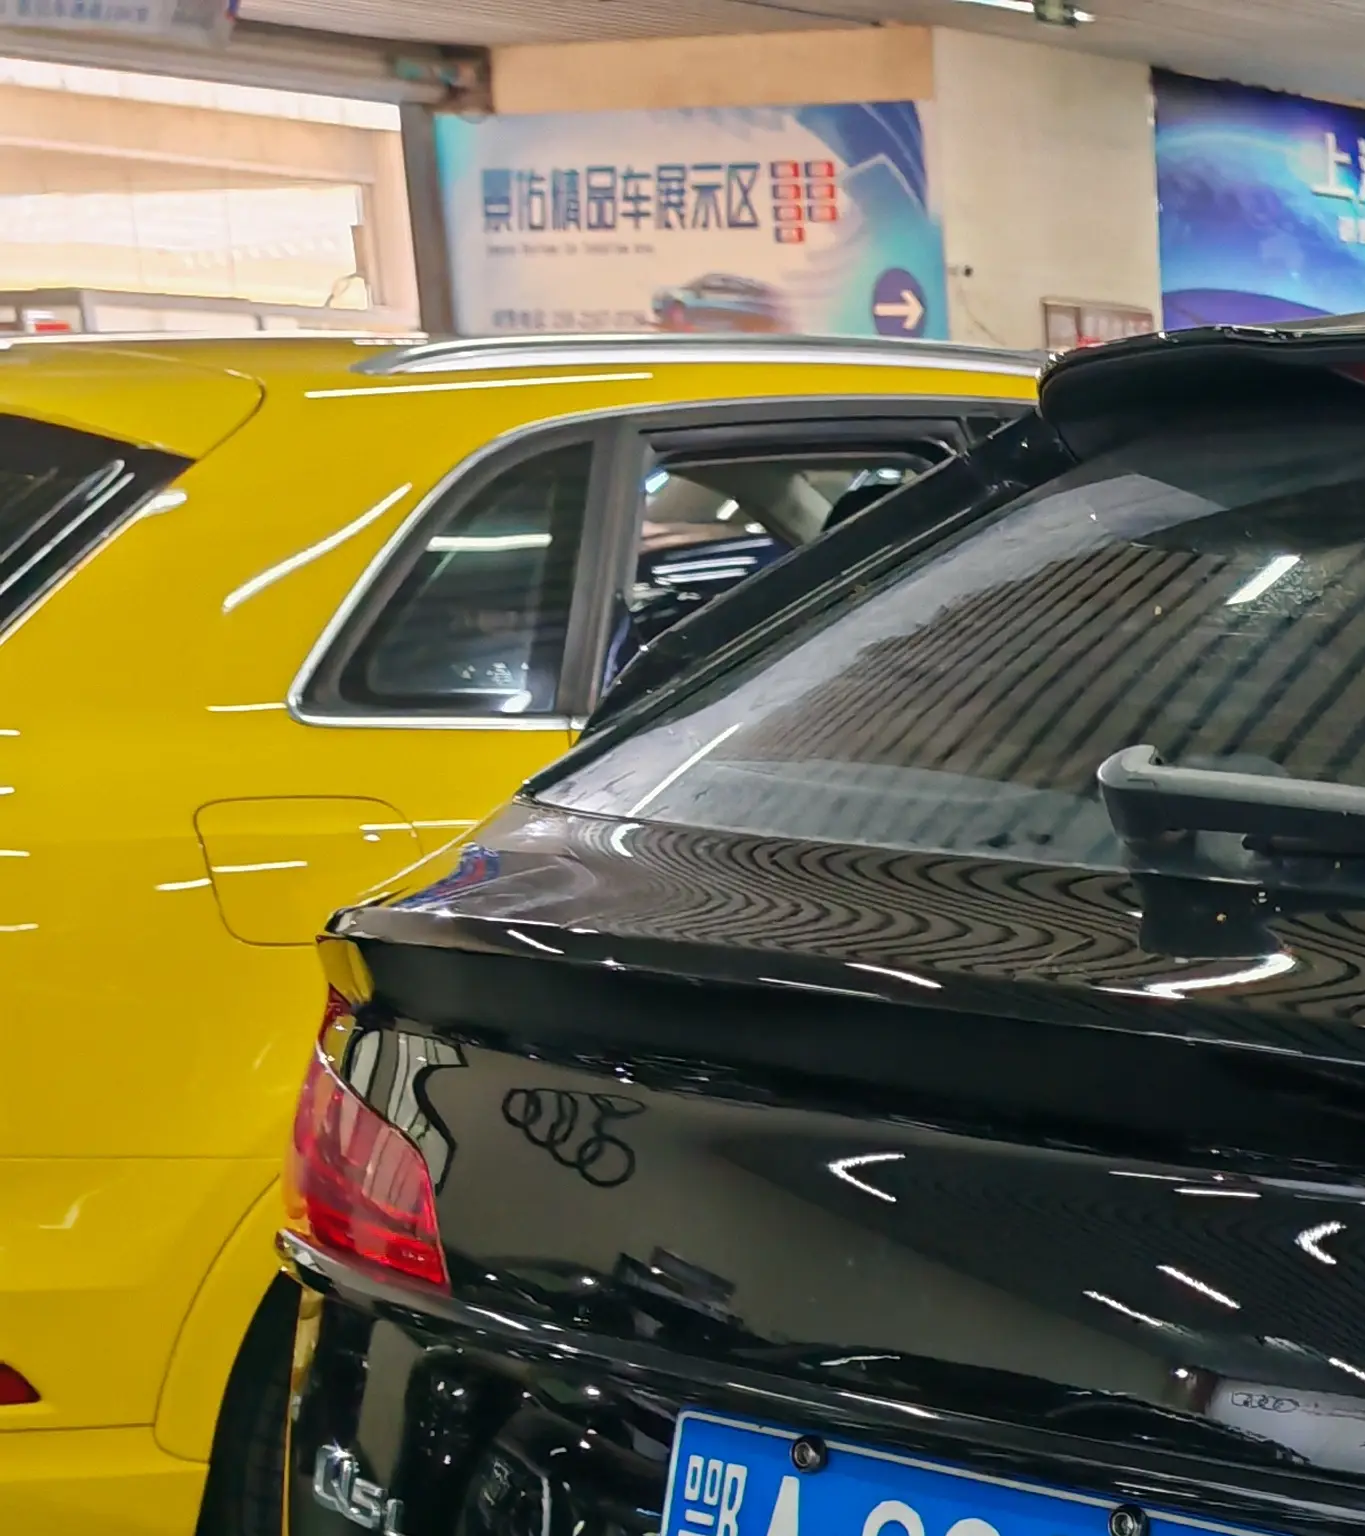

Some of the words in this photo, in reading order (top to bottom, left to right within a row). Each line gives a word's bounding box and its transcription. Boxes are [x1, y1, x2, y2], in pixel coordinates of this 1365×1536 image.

[481, 162, 761, 232] 景佑精品车展示区
